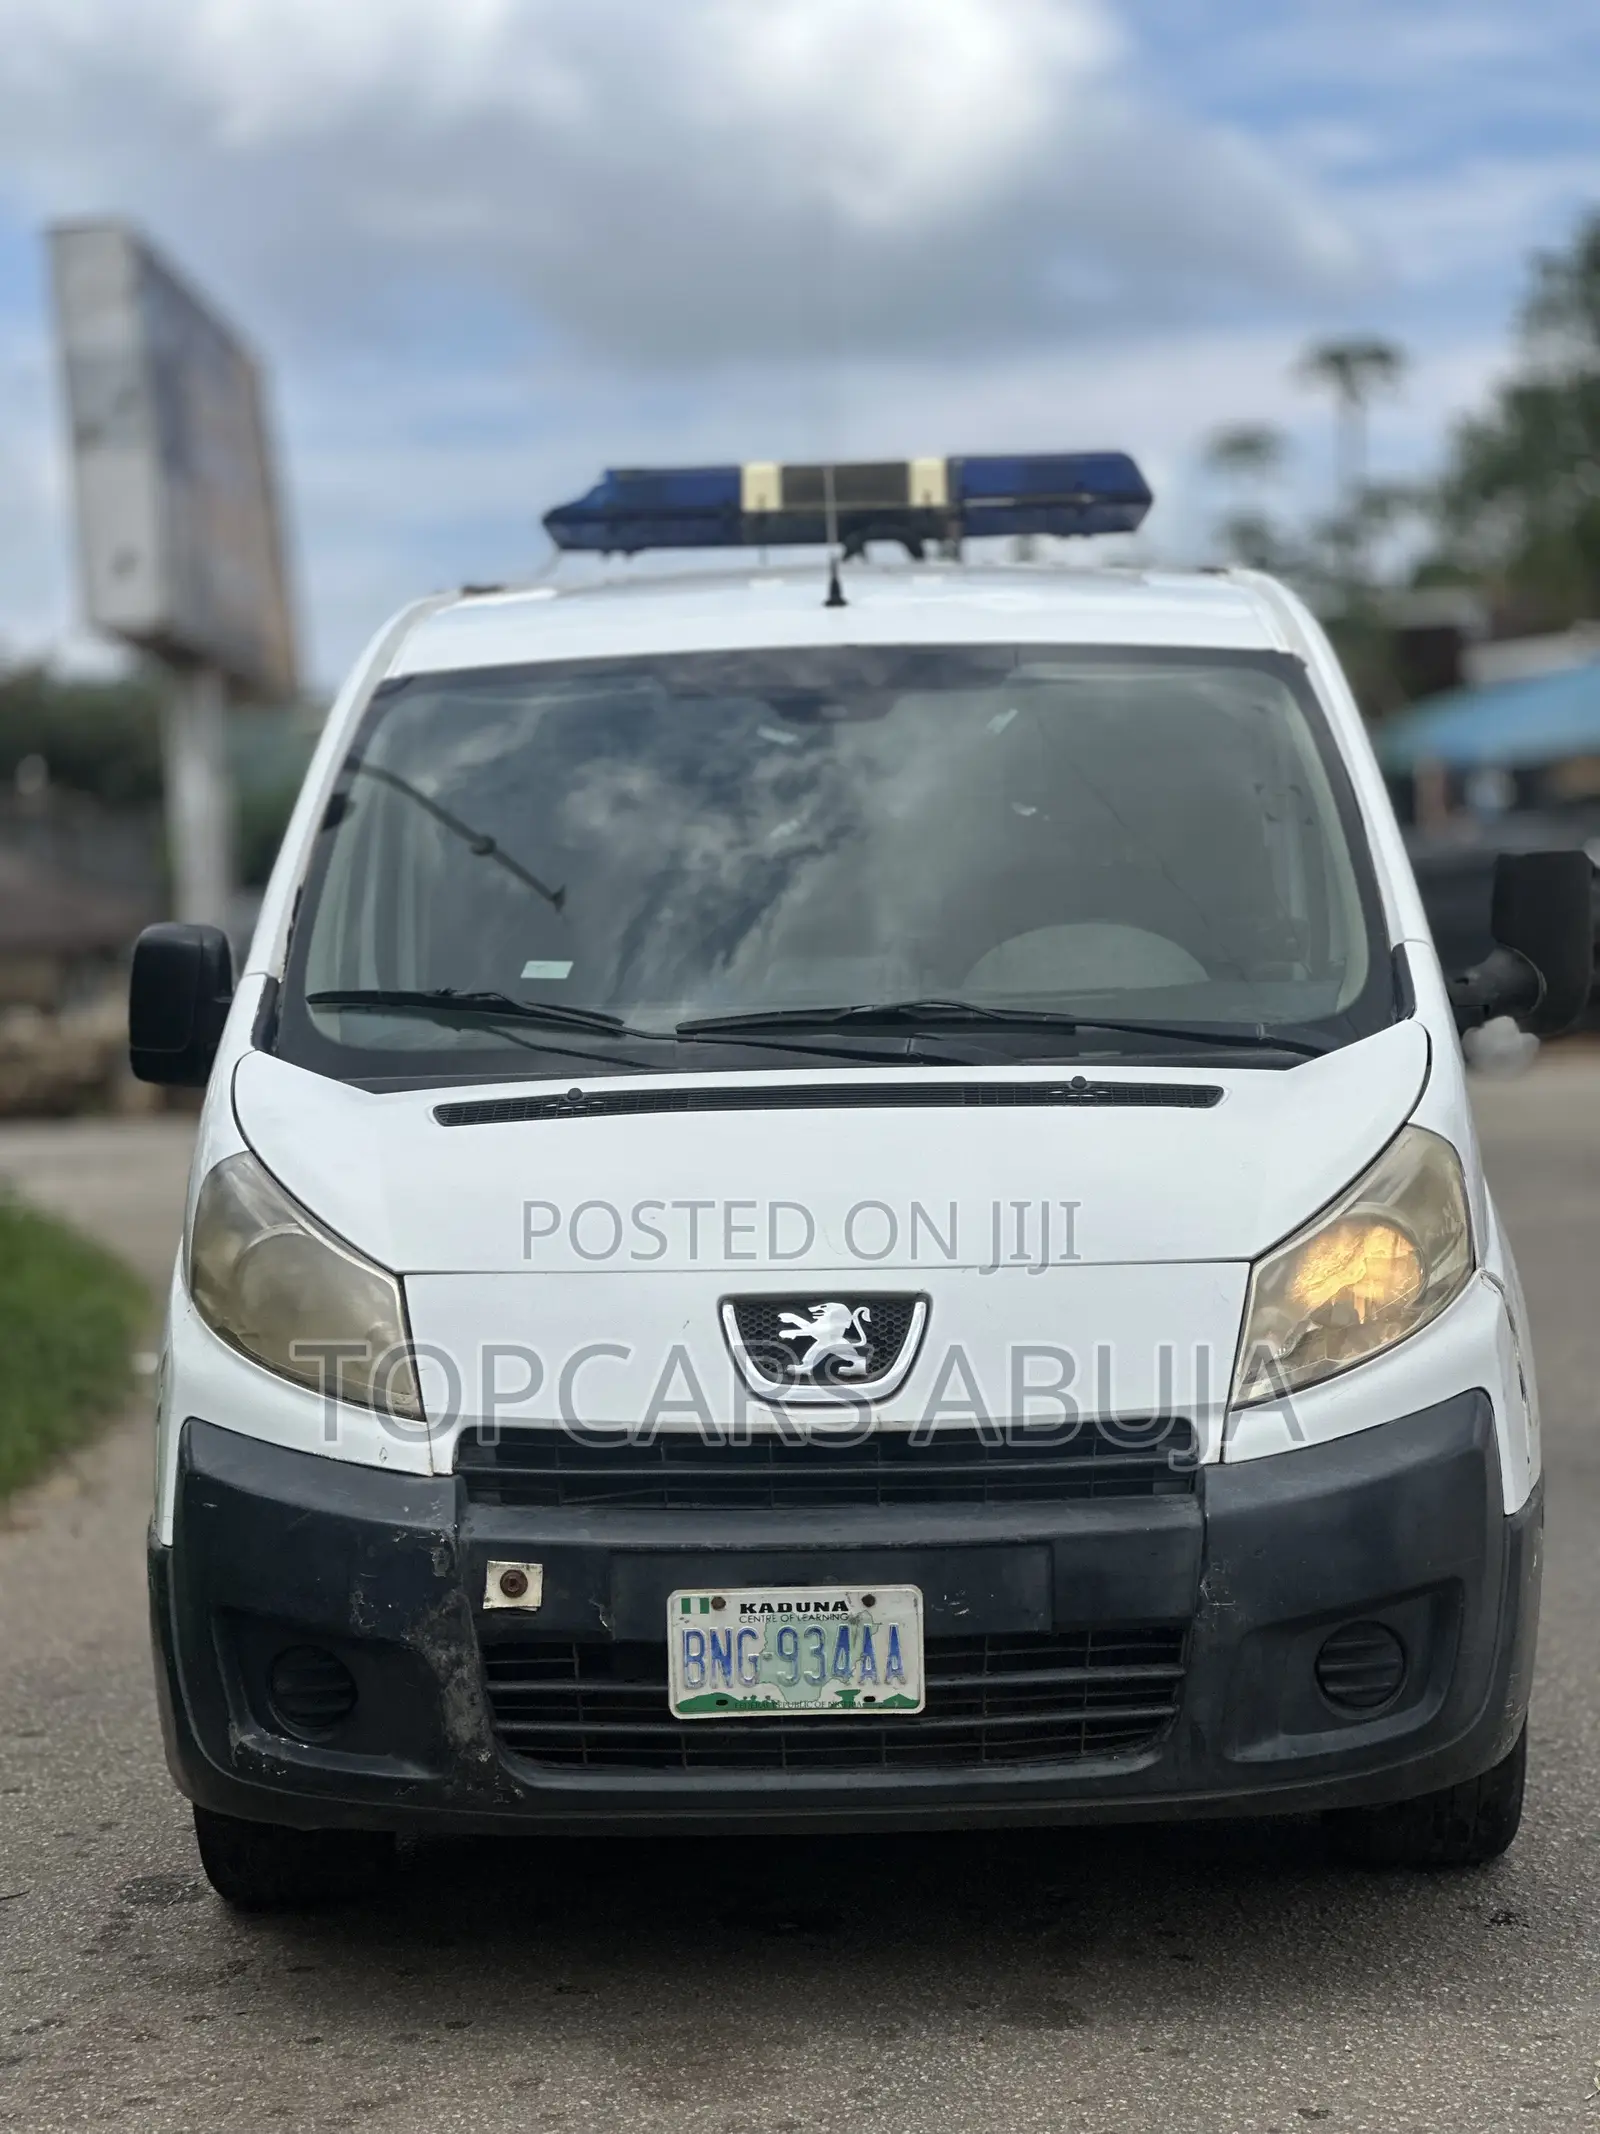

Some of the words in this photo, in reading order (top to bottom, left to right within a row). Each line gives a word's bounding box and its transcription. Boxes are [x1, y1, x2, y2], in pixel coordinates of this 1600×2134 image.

[739, 1600, 849, 1615] KADUNA
[739, 1614, 777, 1624] CENTRE
[780, 1614, 795, 1623] OF
[797, 1612, 850, 1622] LEARNING
